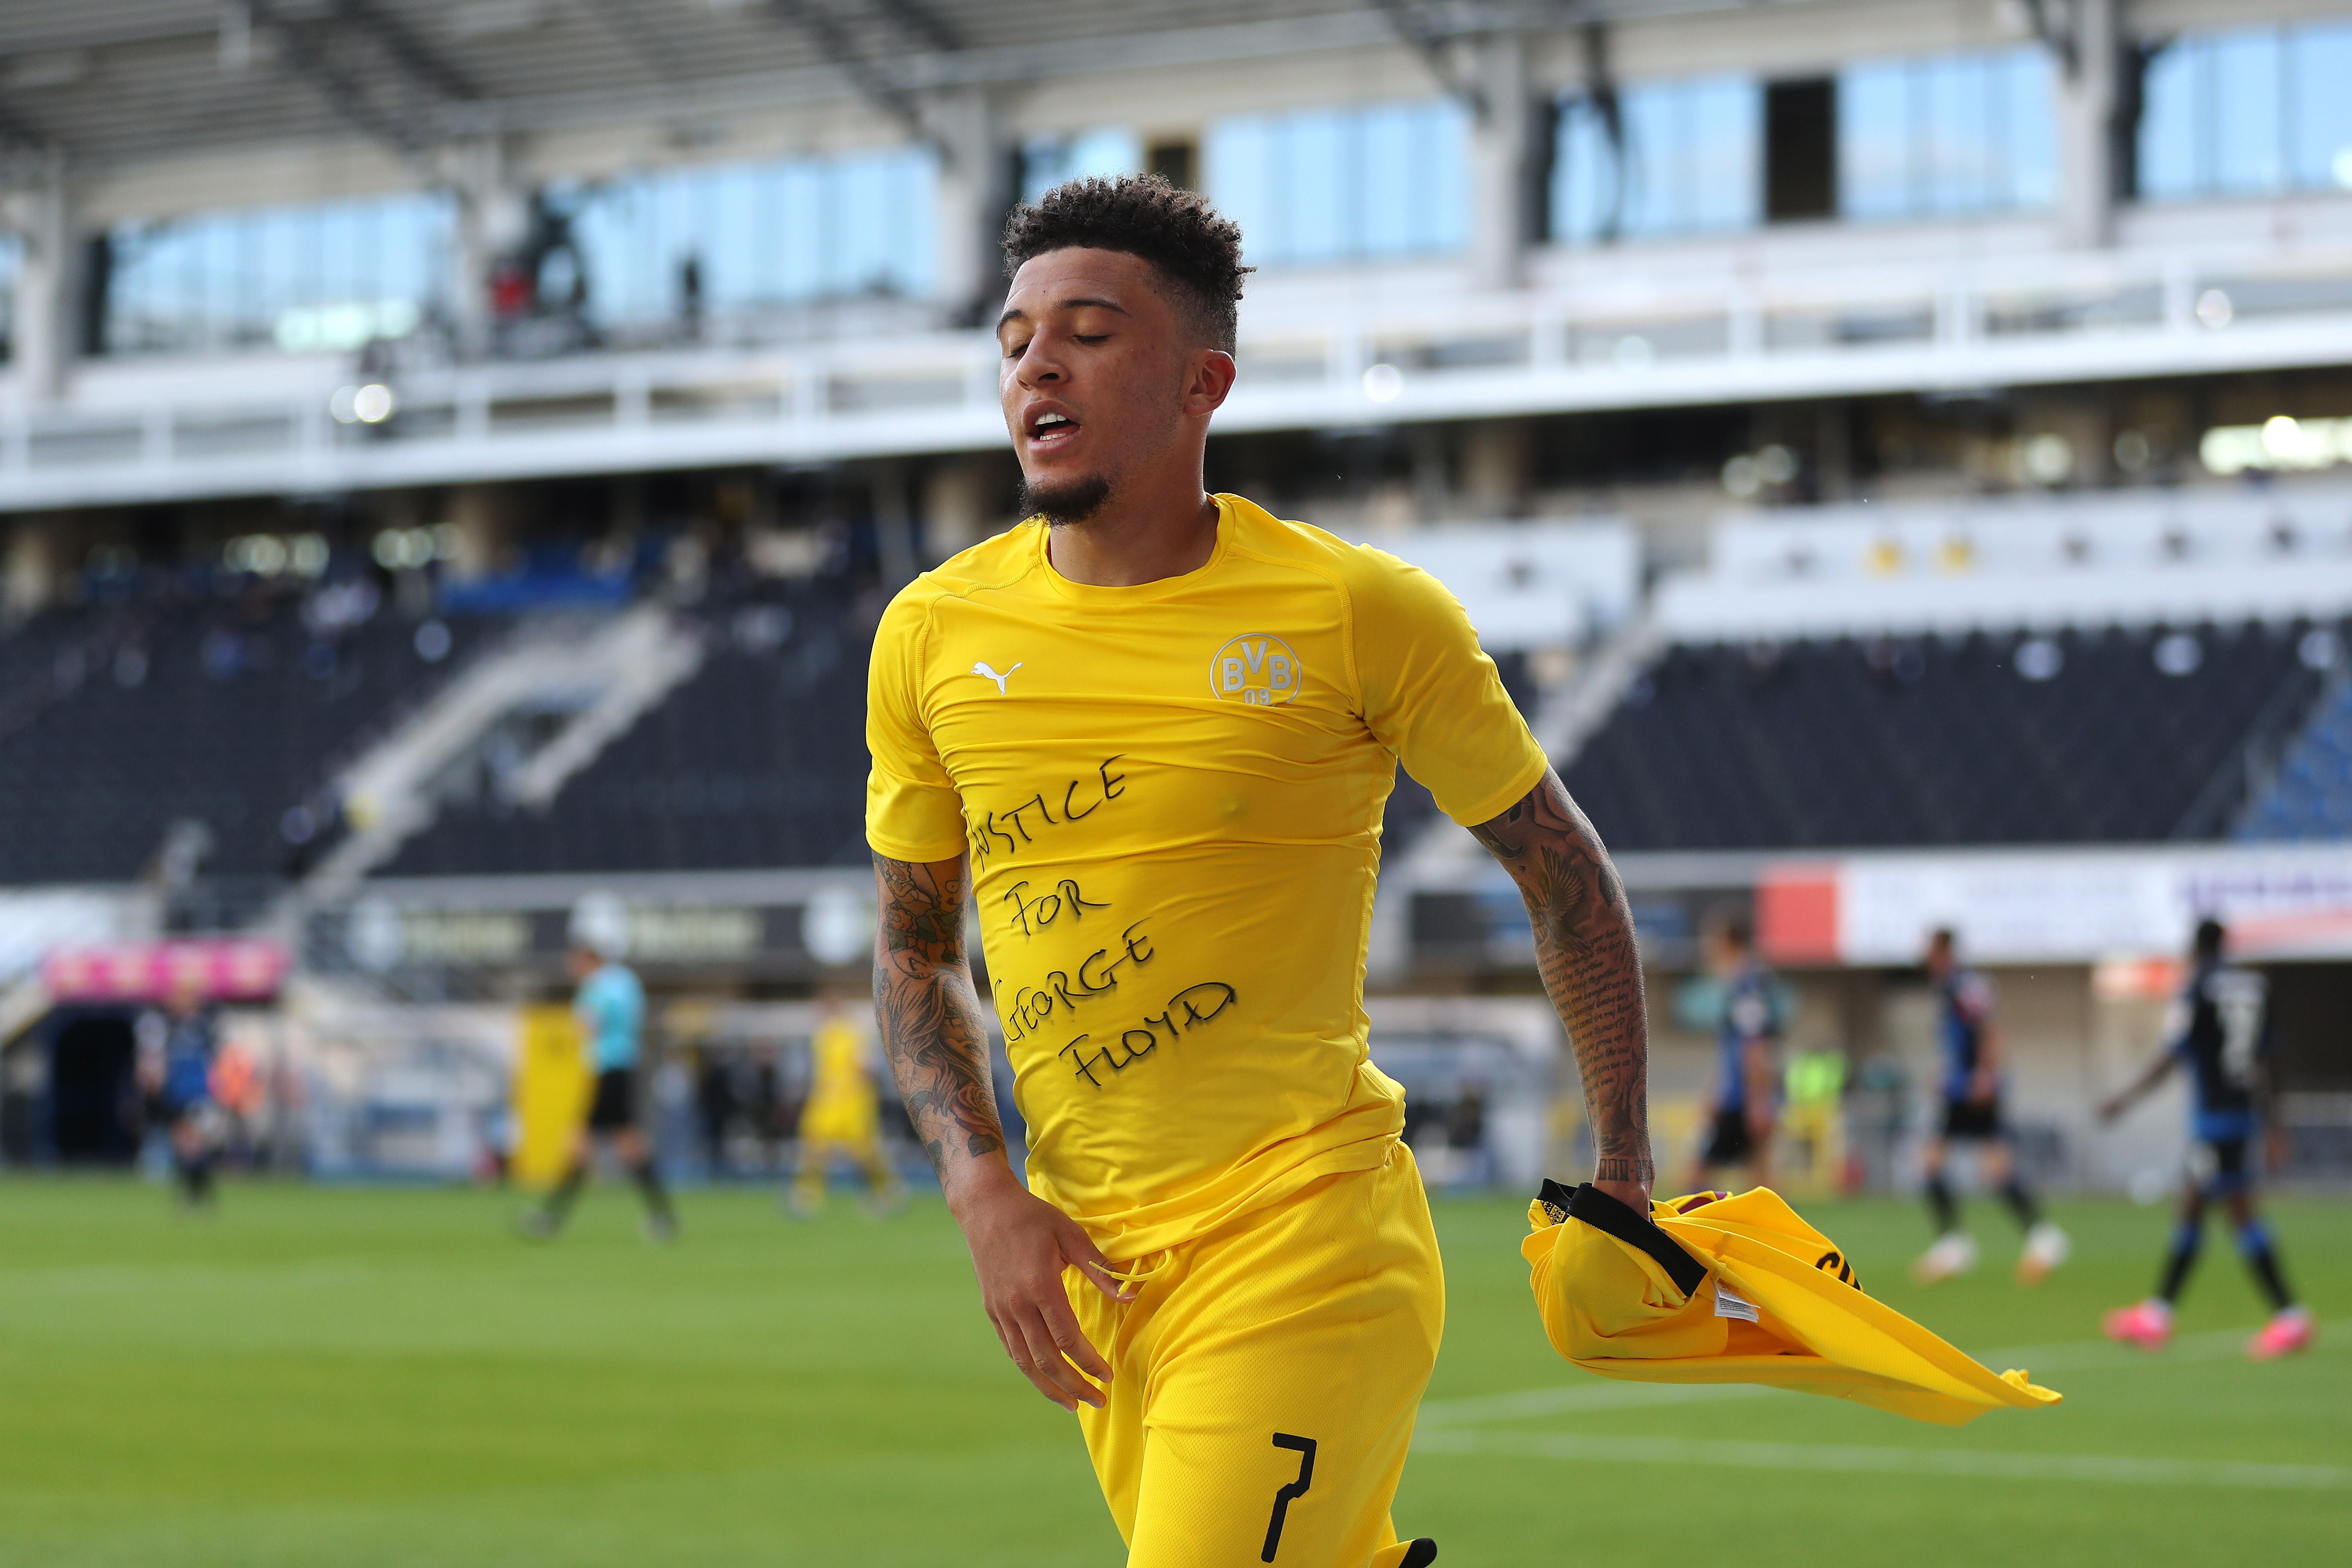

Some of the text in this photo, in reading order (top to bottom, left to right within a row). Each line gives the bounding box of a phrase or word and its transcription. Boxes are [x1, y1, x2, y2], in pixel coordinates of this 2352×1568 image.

[1222, 641, 1292, 692] BVB
[1244, 688, 1271, 706] 09
[1004, 879, 1112, 936] FOR
[994, 916, 1154, 1041] GEORGE
[1058, 981, 1237, 1087] FLOYD
[1261, 1432, 1317, 1563] 7
